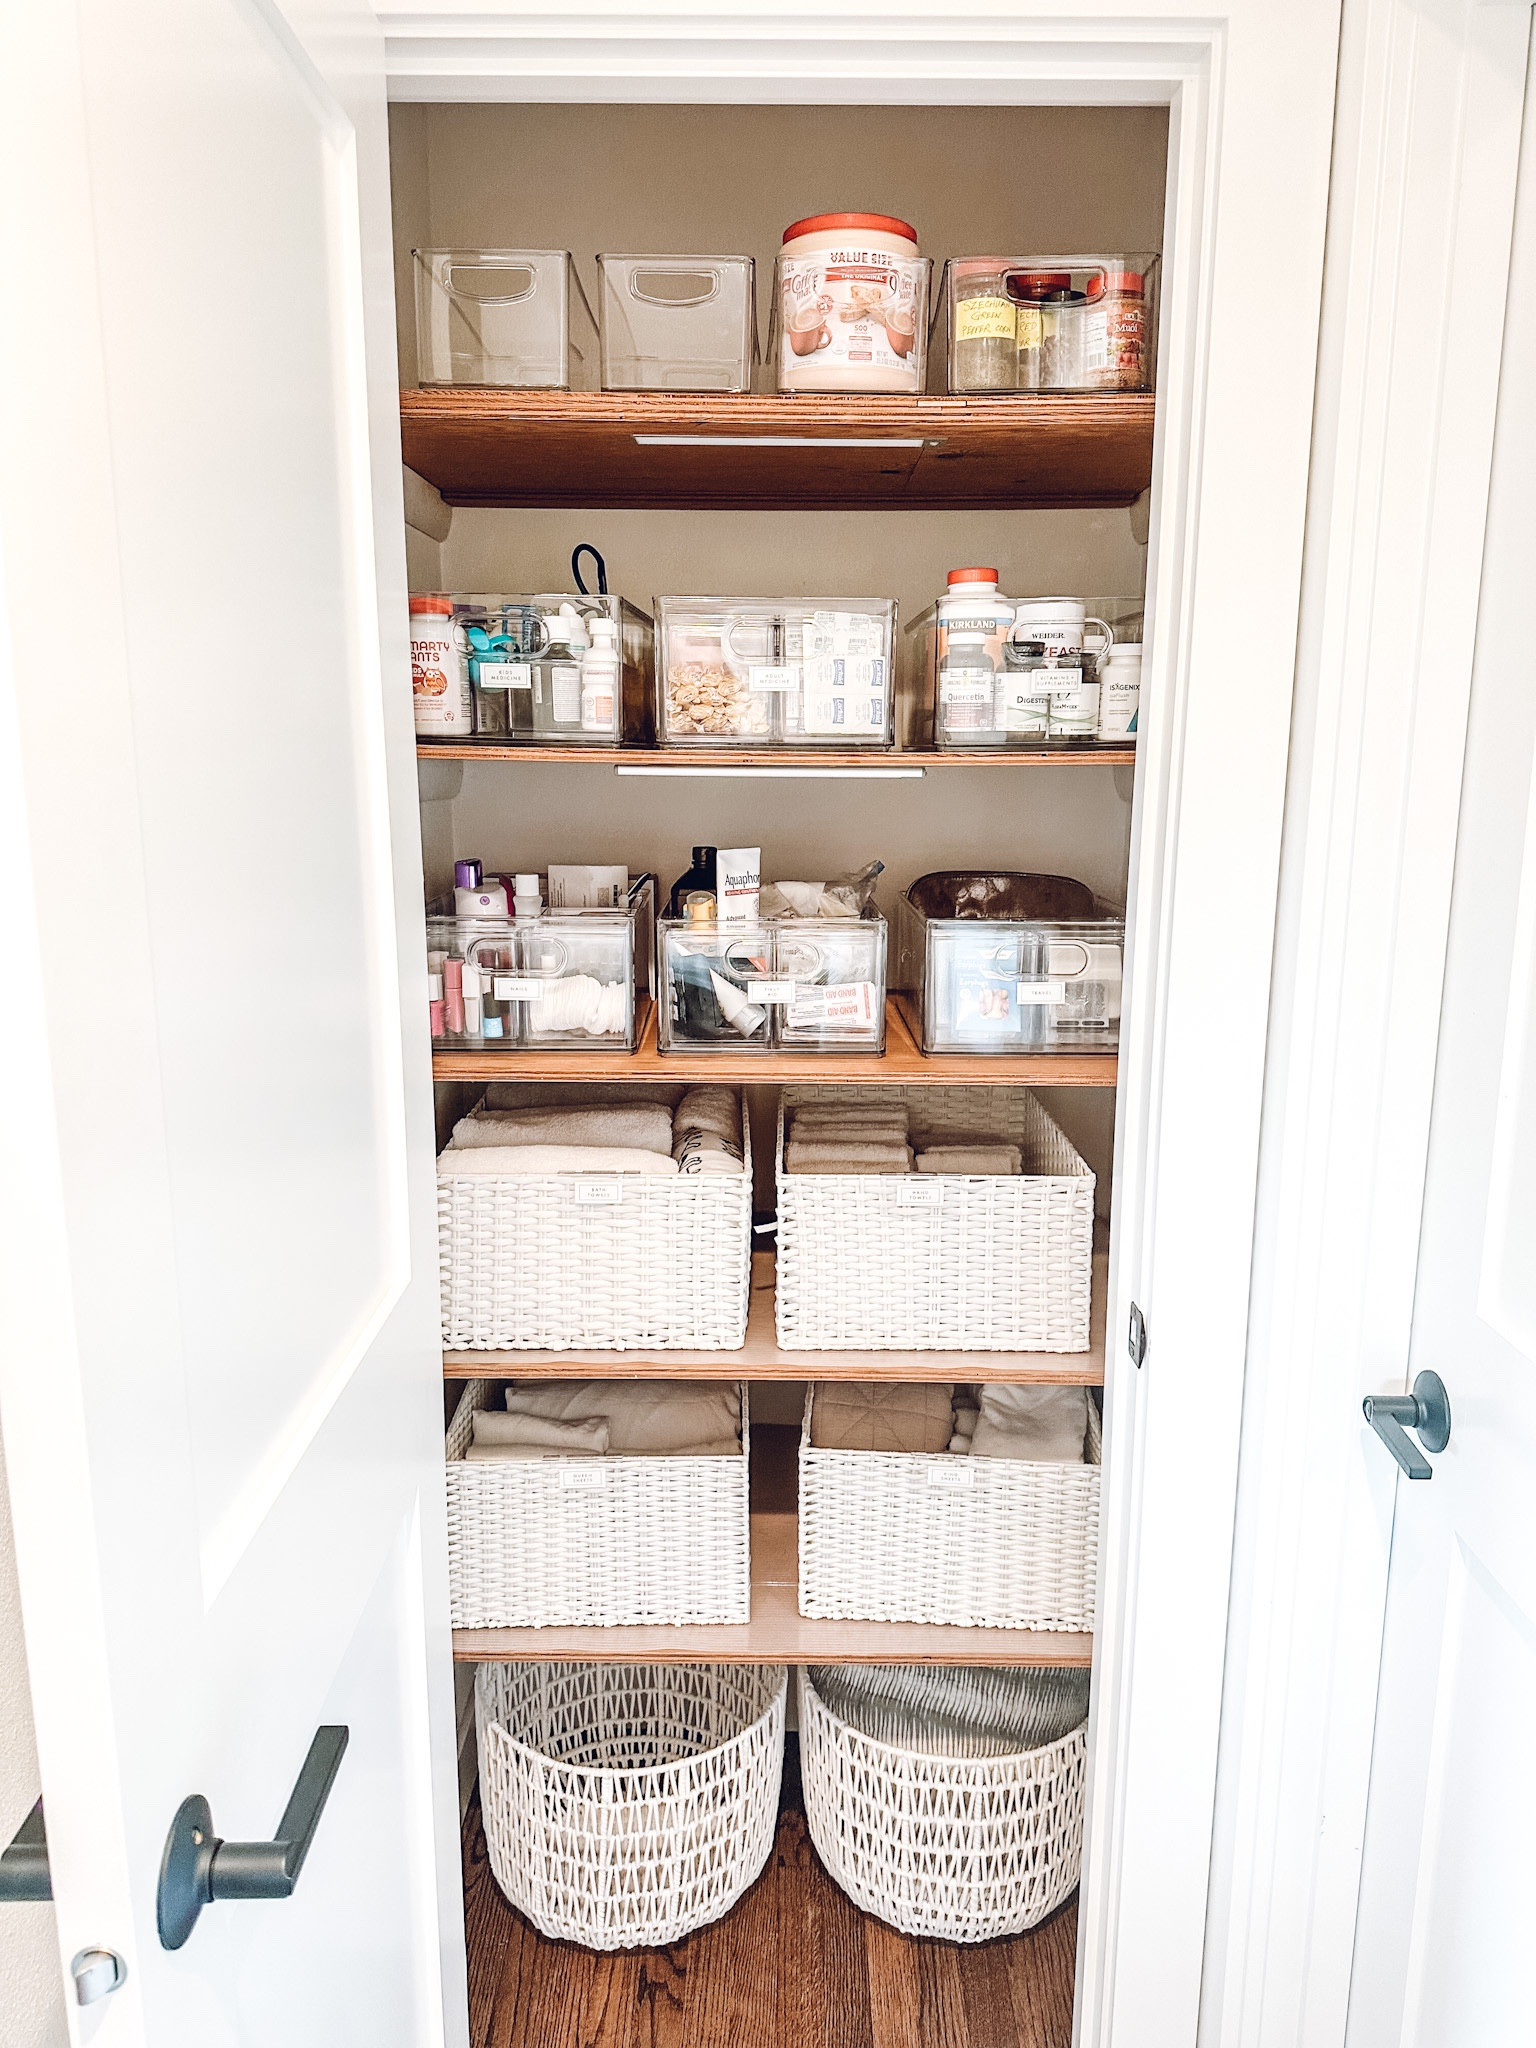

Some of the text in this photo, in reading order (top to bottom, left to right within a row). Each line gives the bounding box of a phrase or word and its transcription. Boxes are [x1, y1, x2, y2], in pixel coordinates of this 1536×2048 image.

[830, 252, 868, 263] VALUE
[948, 619, 996, 630] KIRKLAND
[410, 641, 450, 652] MARTY
[410, 652, 440, 662] ANTS
[948, 692, 985, 702] Quercetin
